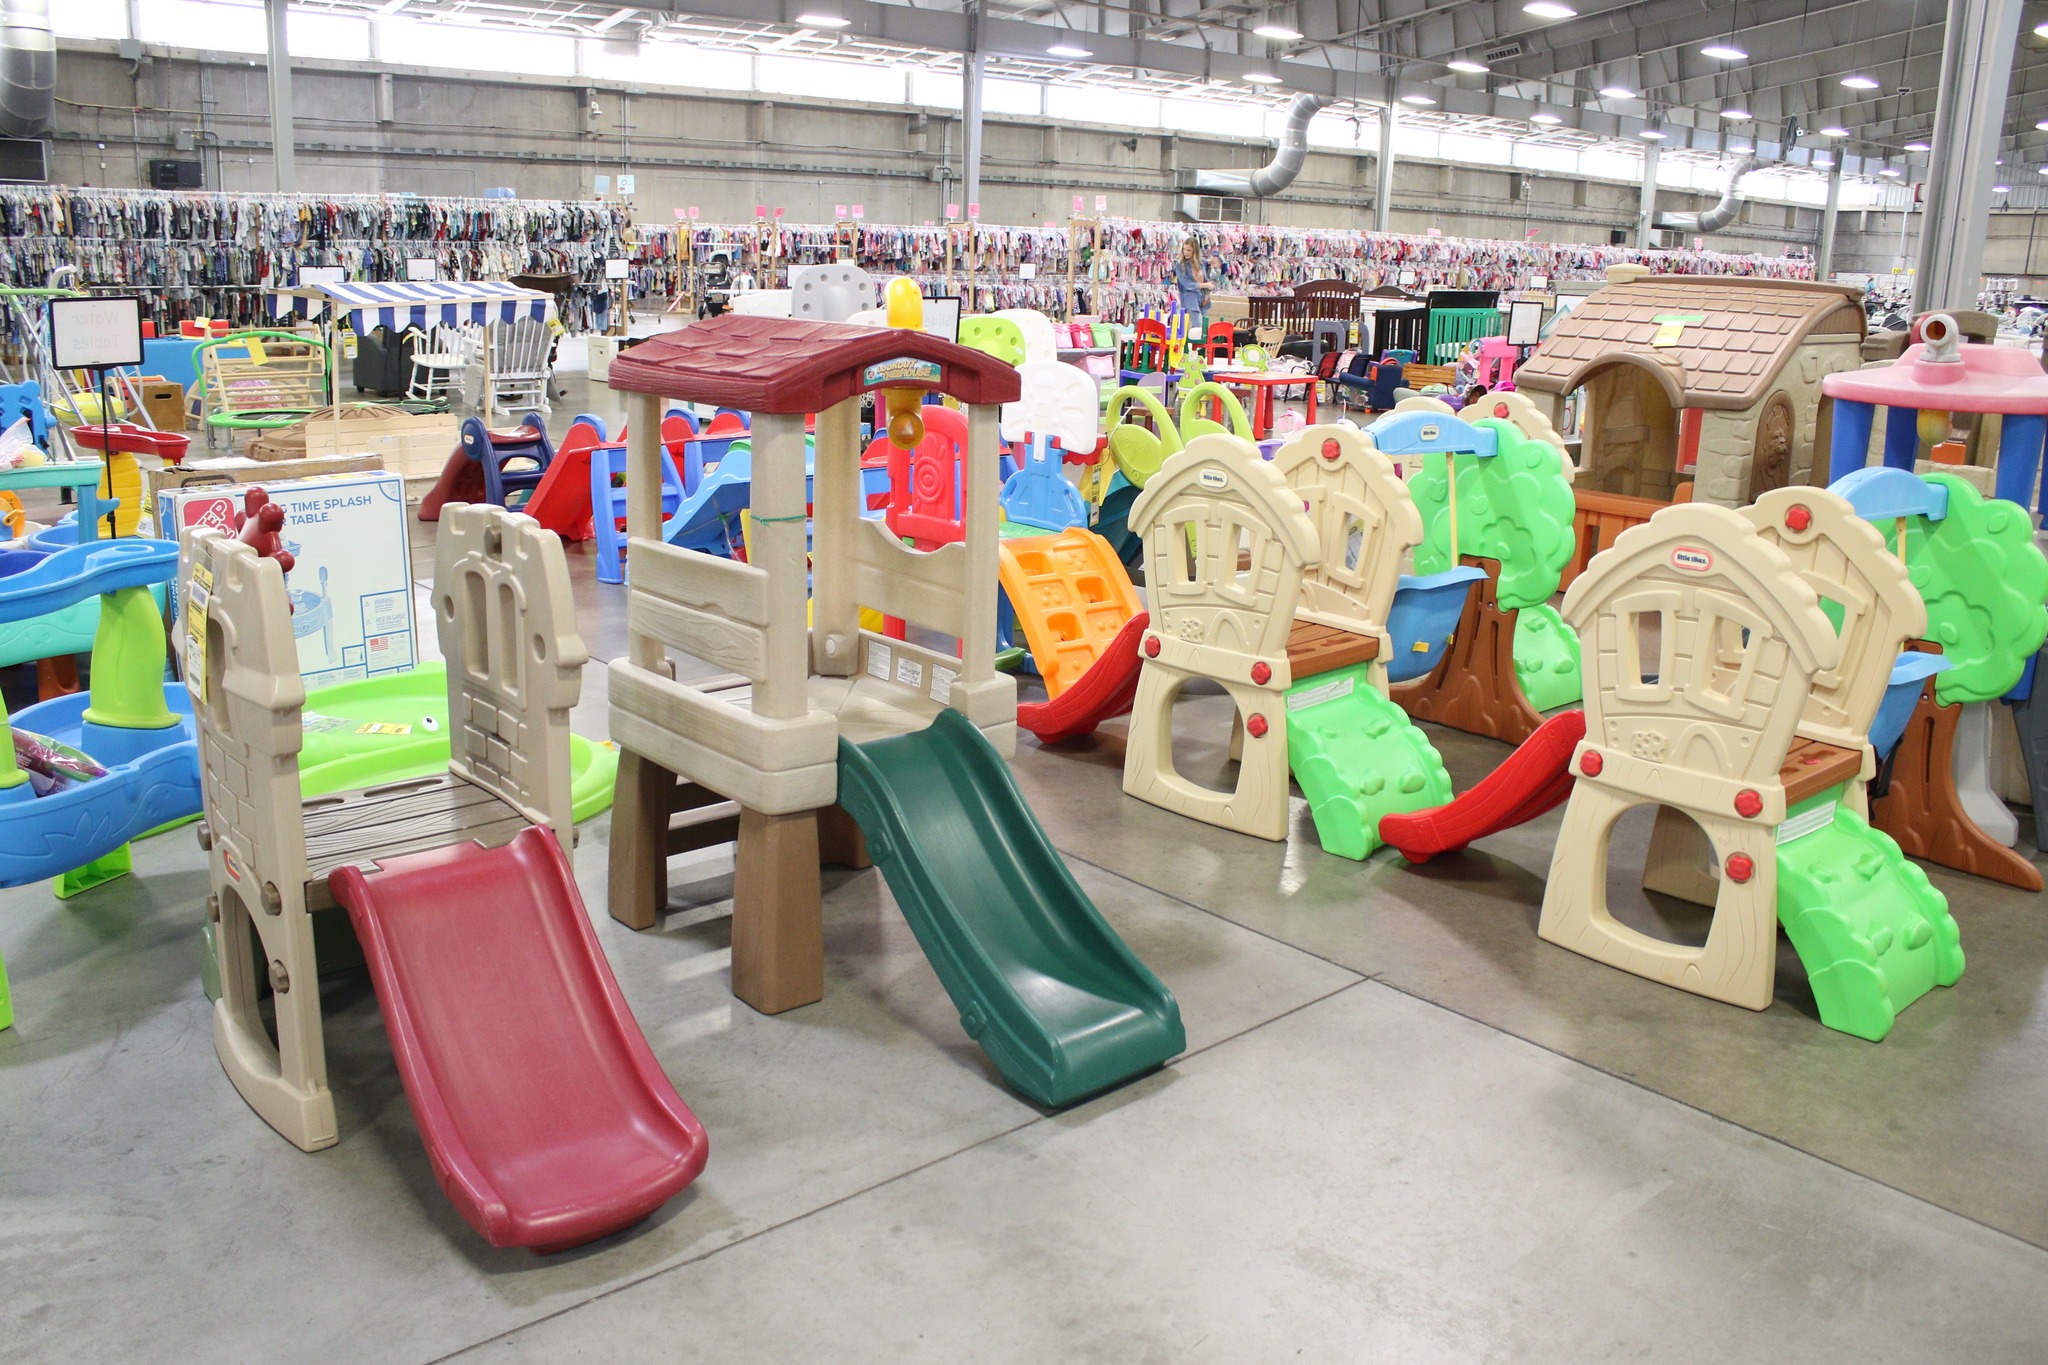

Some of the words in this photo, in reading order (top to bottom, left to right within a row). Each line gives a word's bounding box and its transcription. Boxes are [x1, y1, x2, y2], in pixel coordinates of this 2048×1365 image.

[876, 359, 919, 374] LOOKOUT
[882, 366, 933, 380] TREEHOUSE
[291, 500, 321, 513] TIME
[324, 495, 372, 509] SPLASH
[290, 512, 329, 525] TABLE
[1677, 553, 1690, 562] little
